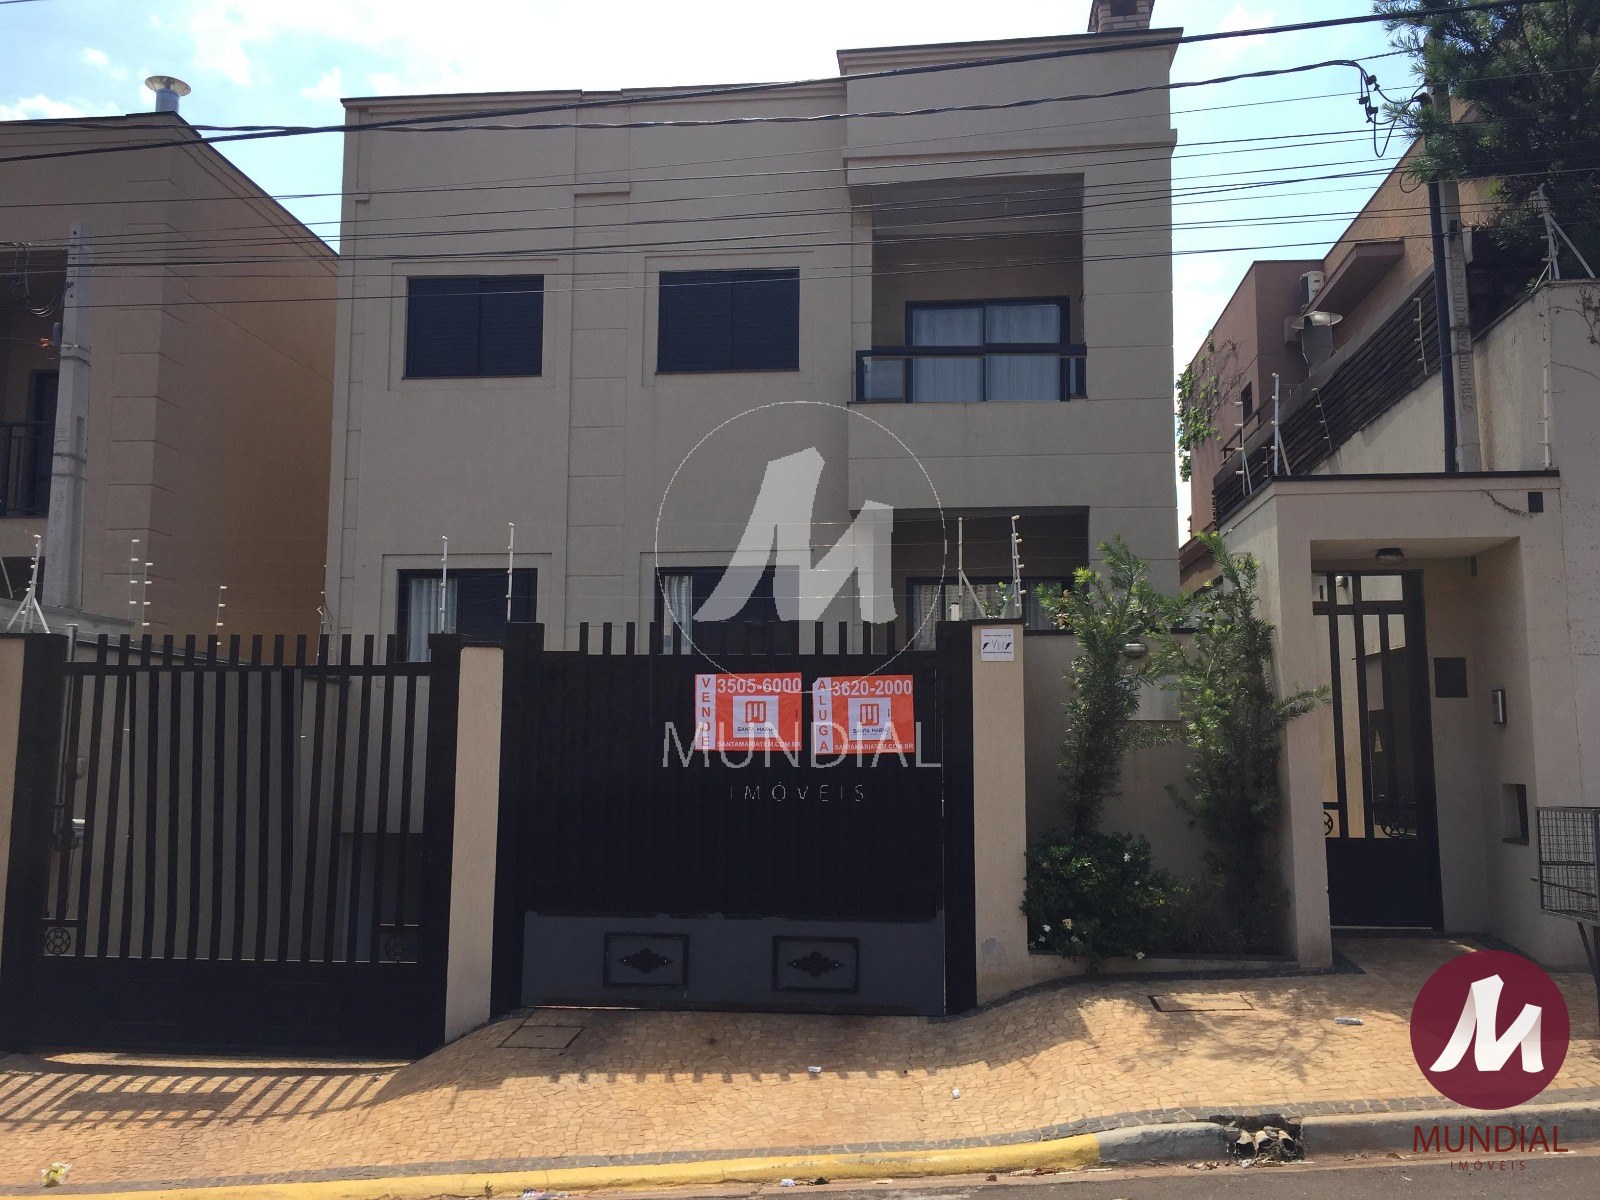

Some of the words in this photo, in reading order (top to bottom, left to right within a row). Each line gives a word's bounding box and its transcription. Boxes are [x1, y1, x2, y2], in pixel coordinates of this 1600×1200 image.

[717, 677, 802, 694] 3505-6000
[832, 679, 913, 696] 3620-2000
[702, 678, 711, 747] VENDE
[818, 679, 829, 751] ALUGA
